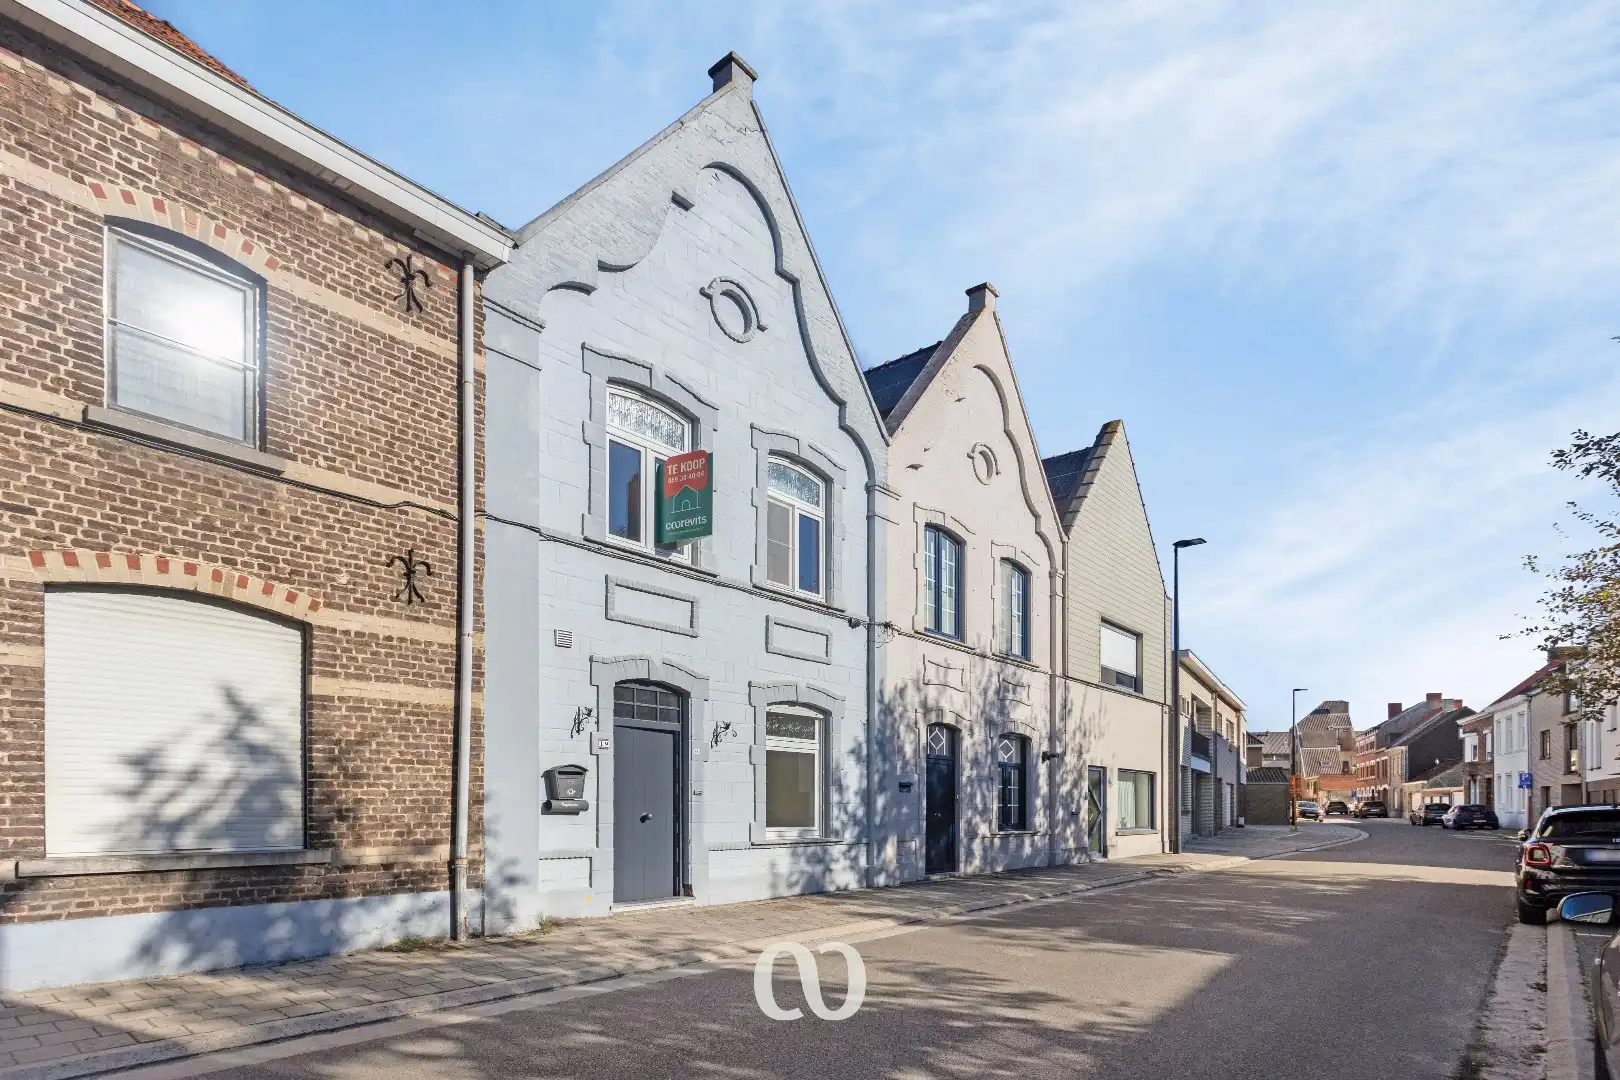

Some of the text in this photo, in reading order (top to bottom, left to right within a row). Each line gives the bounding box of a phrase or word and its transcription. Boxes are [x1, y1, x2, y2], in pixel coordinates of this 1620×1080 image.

[667, 458, 706, 475] TE KOOP
[665, 515, 707, 531] coorevits
[1521, 773, 1530, 781] P
